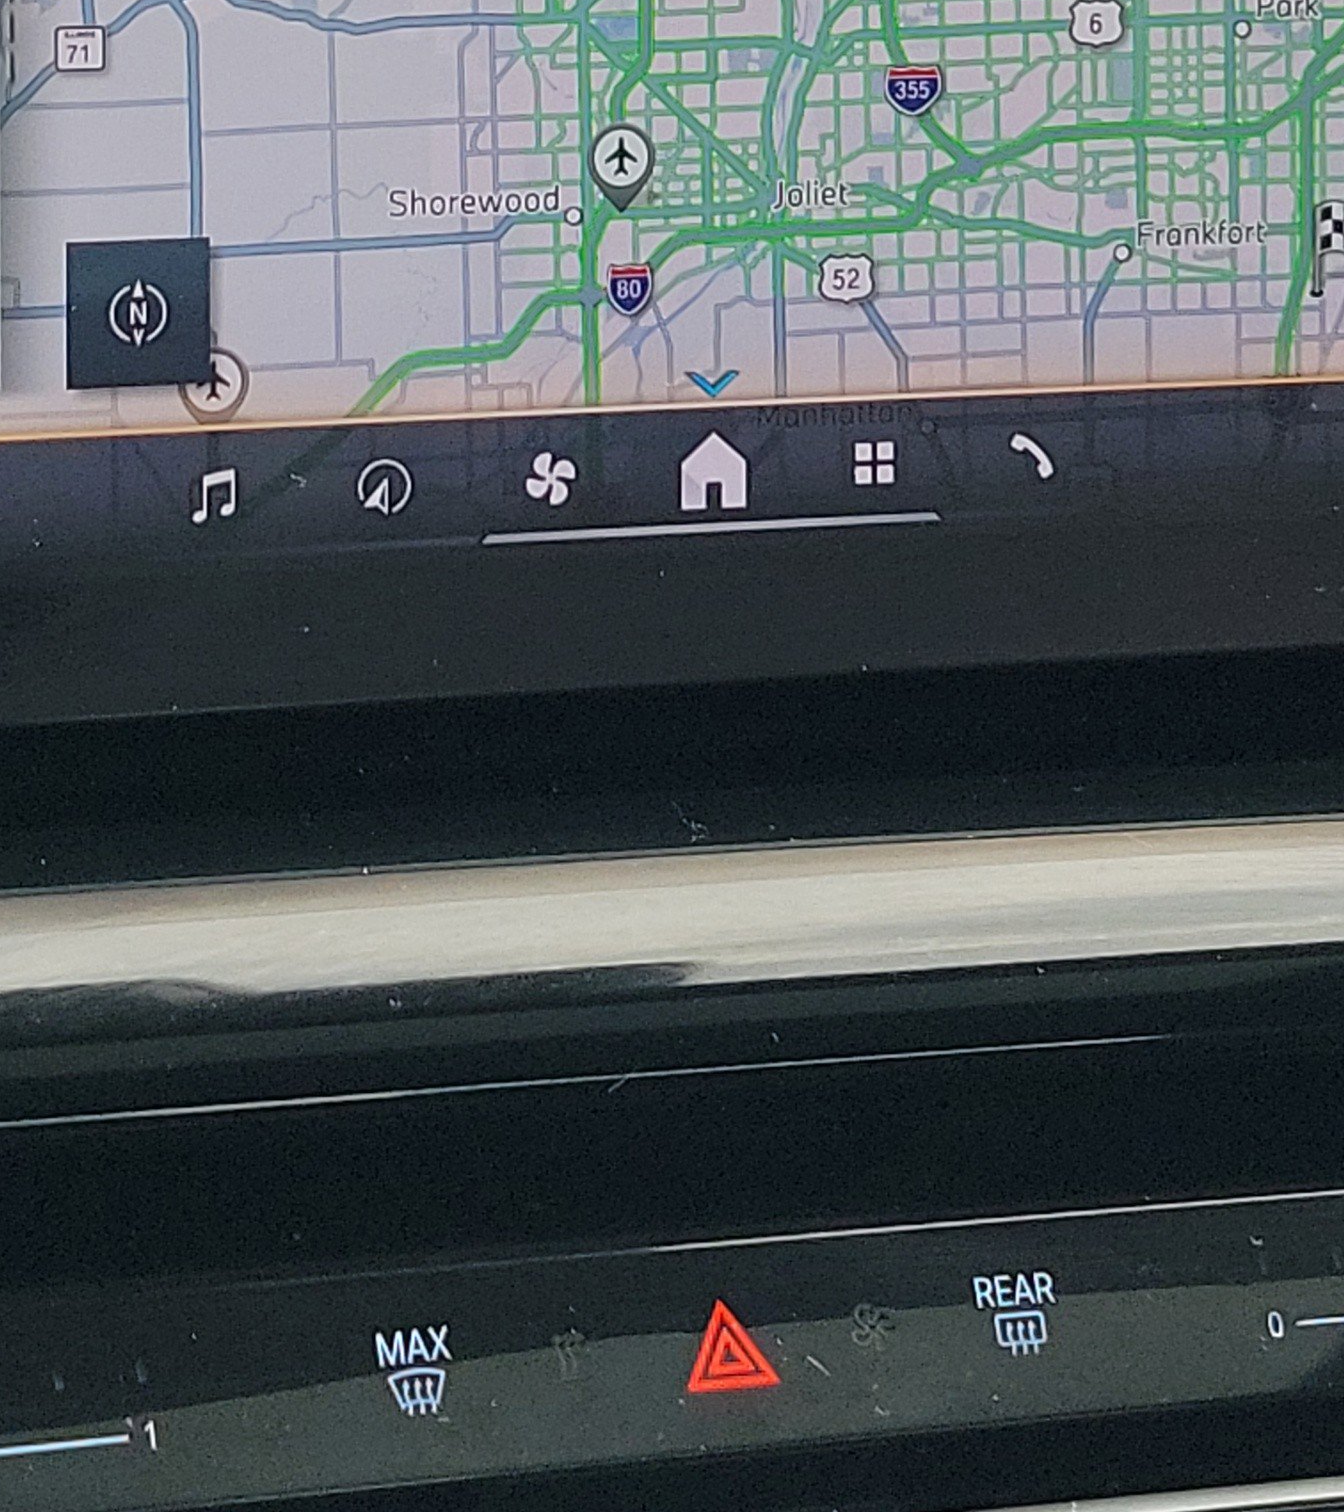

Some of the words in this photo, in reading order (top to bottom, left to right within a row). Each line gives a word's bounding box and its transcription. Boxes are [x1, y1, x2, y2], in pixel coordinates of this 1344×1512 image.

[1090, 14, 1102, 33] 6
[67, 45, 88, 63] 71
[895, 81, 931, 100] 355
[389, 187, 561, 216] Shorewood
[774, 183, 849, 208] Joliet
[1137, 222, 1266, 247] Frankfort
[616, 279, 641, 299] 80
[833, 269, 861, 290] 52
[974, 1271, 1055, 1310] REAR
[375, 1325, 452, 1368] MAX
[142, 1419, 158, 1452] 1
